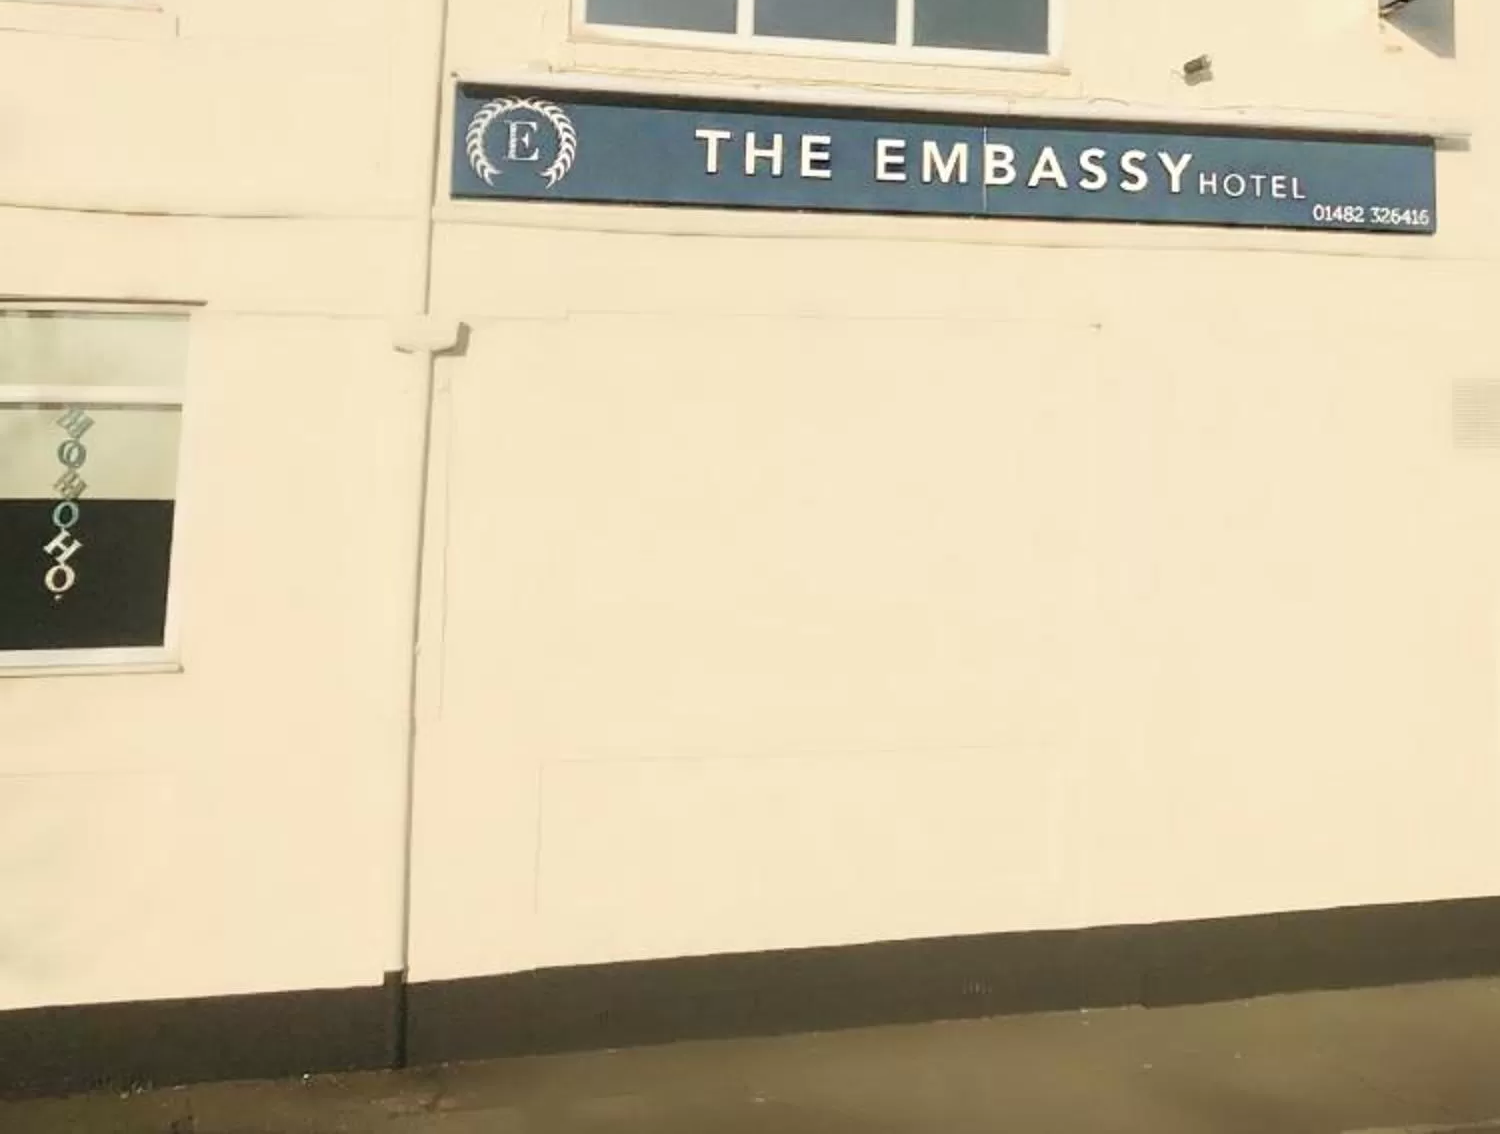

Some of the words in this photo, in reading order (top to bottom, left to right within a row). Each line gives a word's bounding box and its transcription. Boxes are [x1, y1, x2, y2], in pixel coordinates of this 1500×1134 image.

[505, 120, 540, 161] E
[695, 128, 832, 179] THE
[876, 138, 1193, 193] EMBASSY
[1199, 172, 1306, 199] HOTEL
[1312, 203, 1365, 223] 01482
